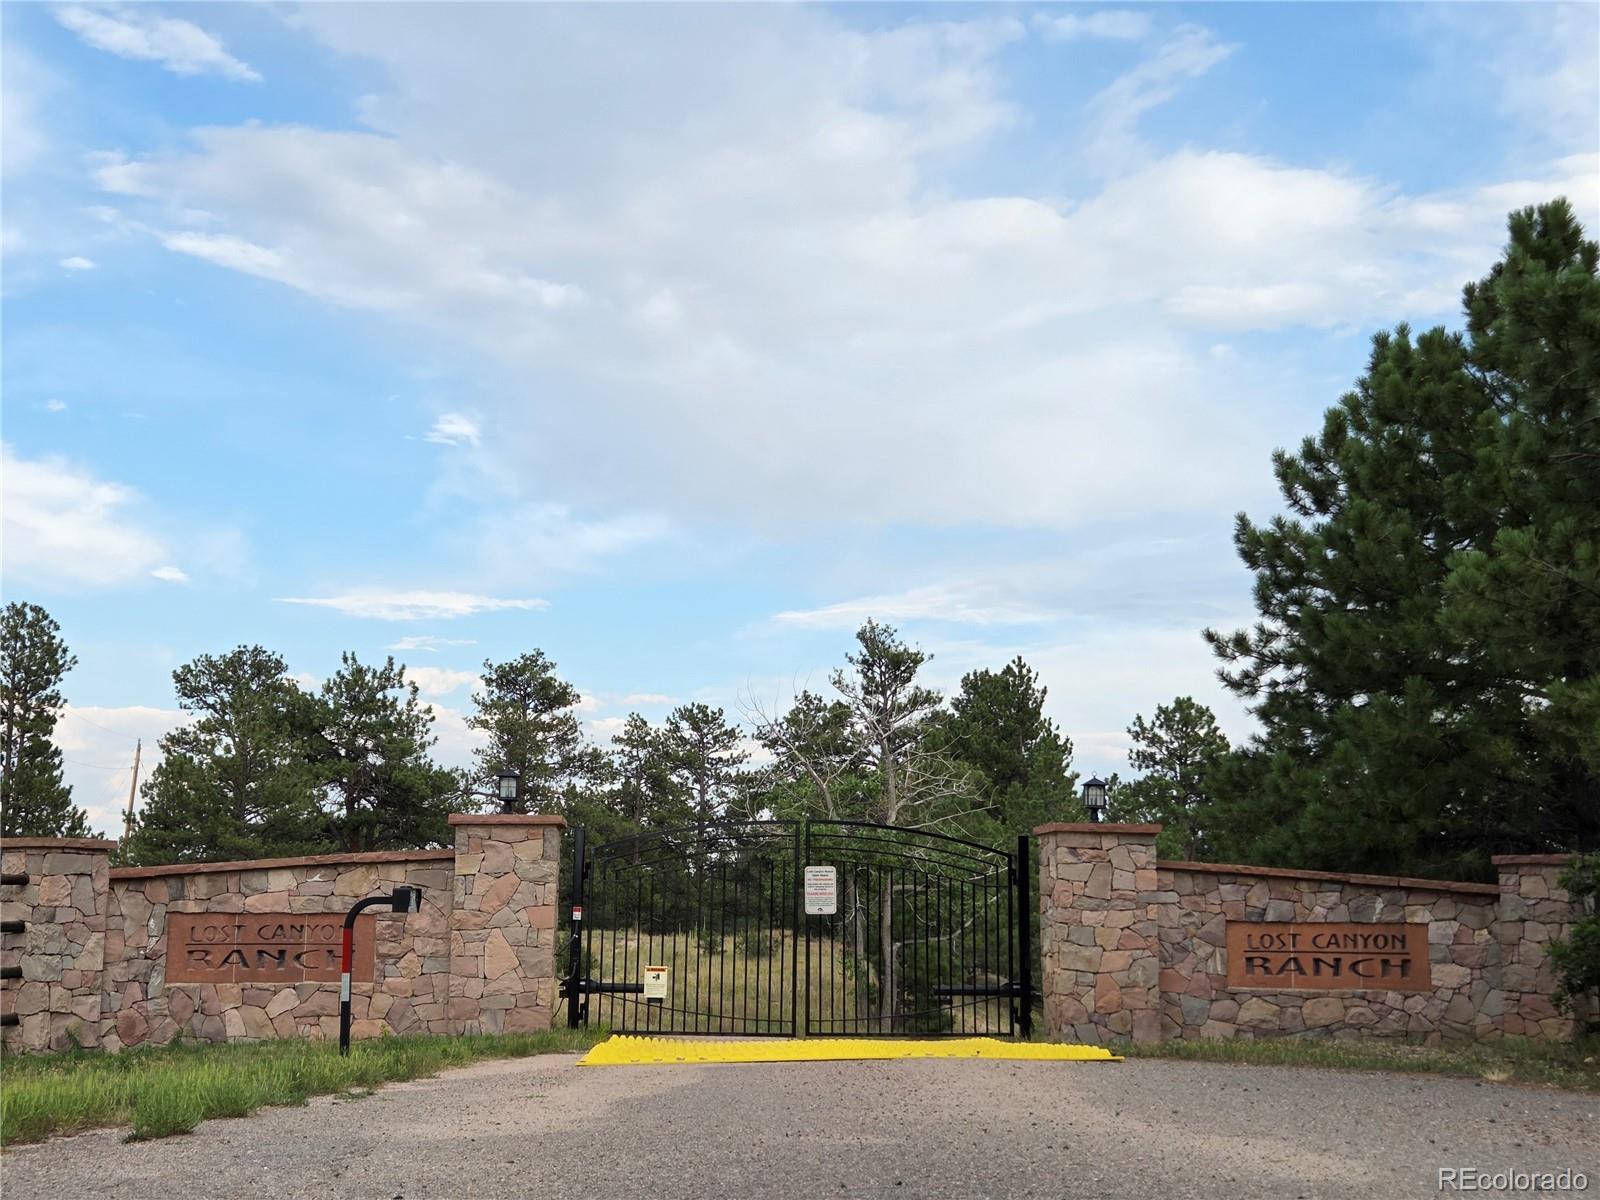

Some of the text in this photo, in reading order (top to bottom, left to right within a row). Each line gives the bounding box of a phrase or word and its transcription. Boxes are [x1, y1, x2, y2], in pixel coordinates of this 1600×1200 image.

[190, 924, 248, 942] LOST
[1247, 933, 1407, 951] LOST CANYON
[187, 949, 355, 970] RANCH
[1245, 956, 1412, 978] RANCH
